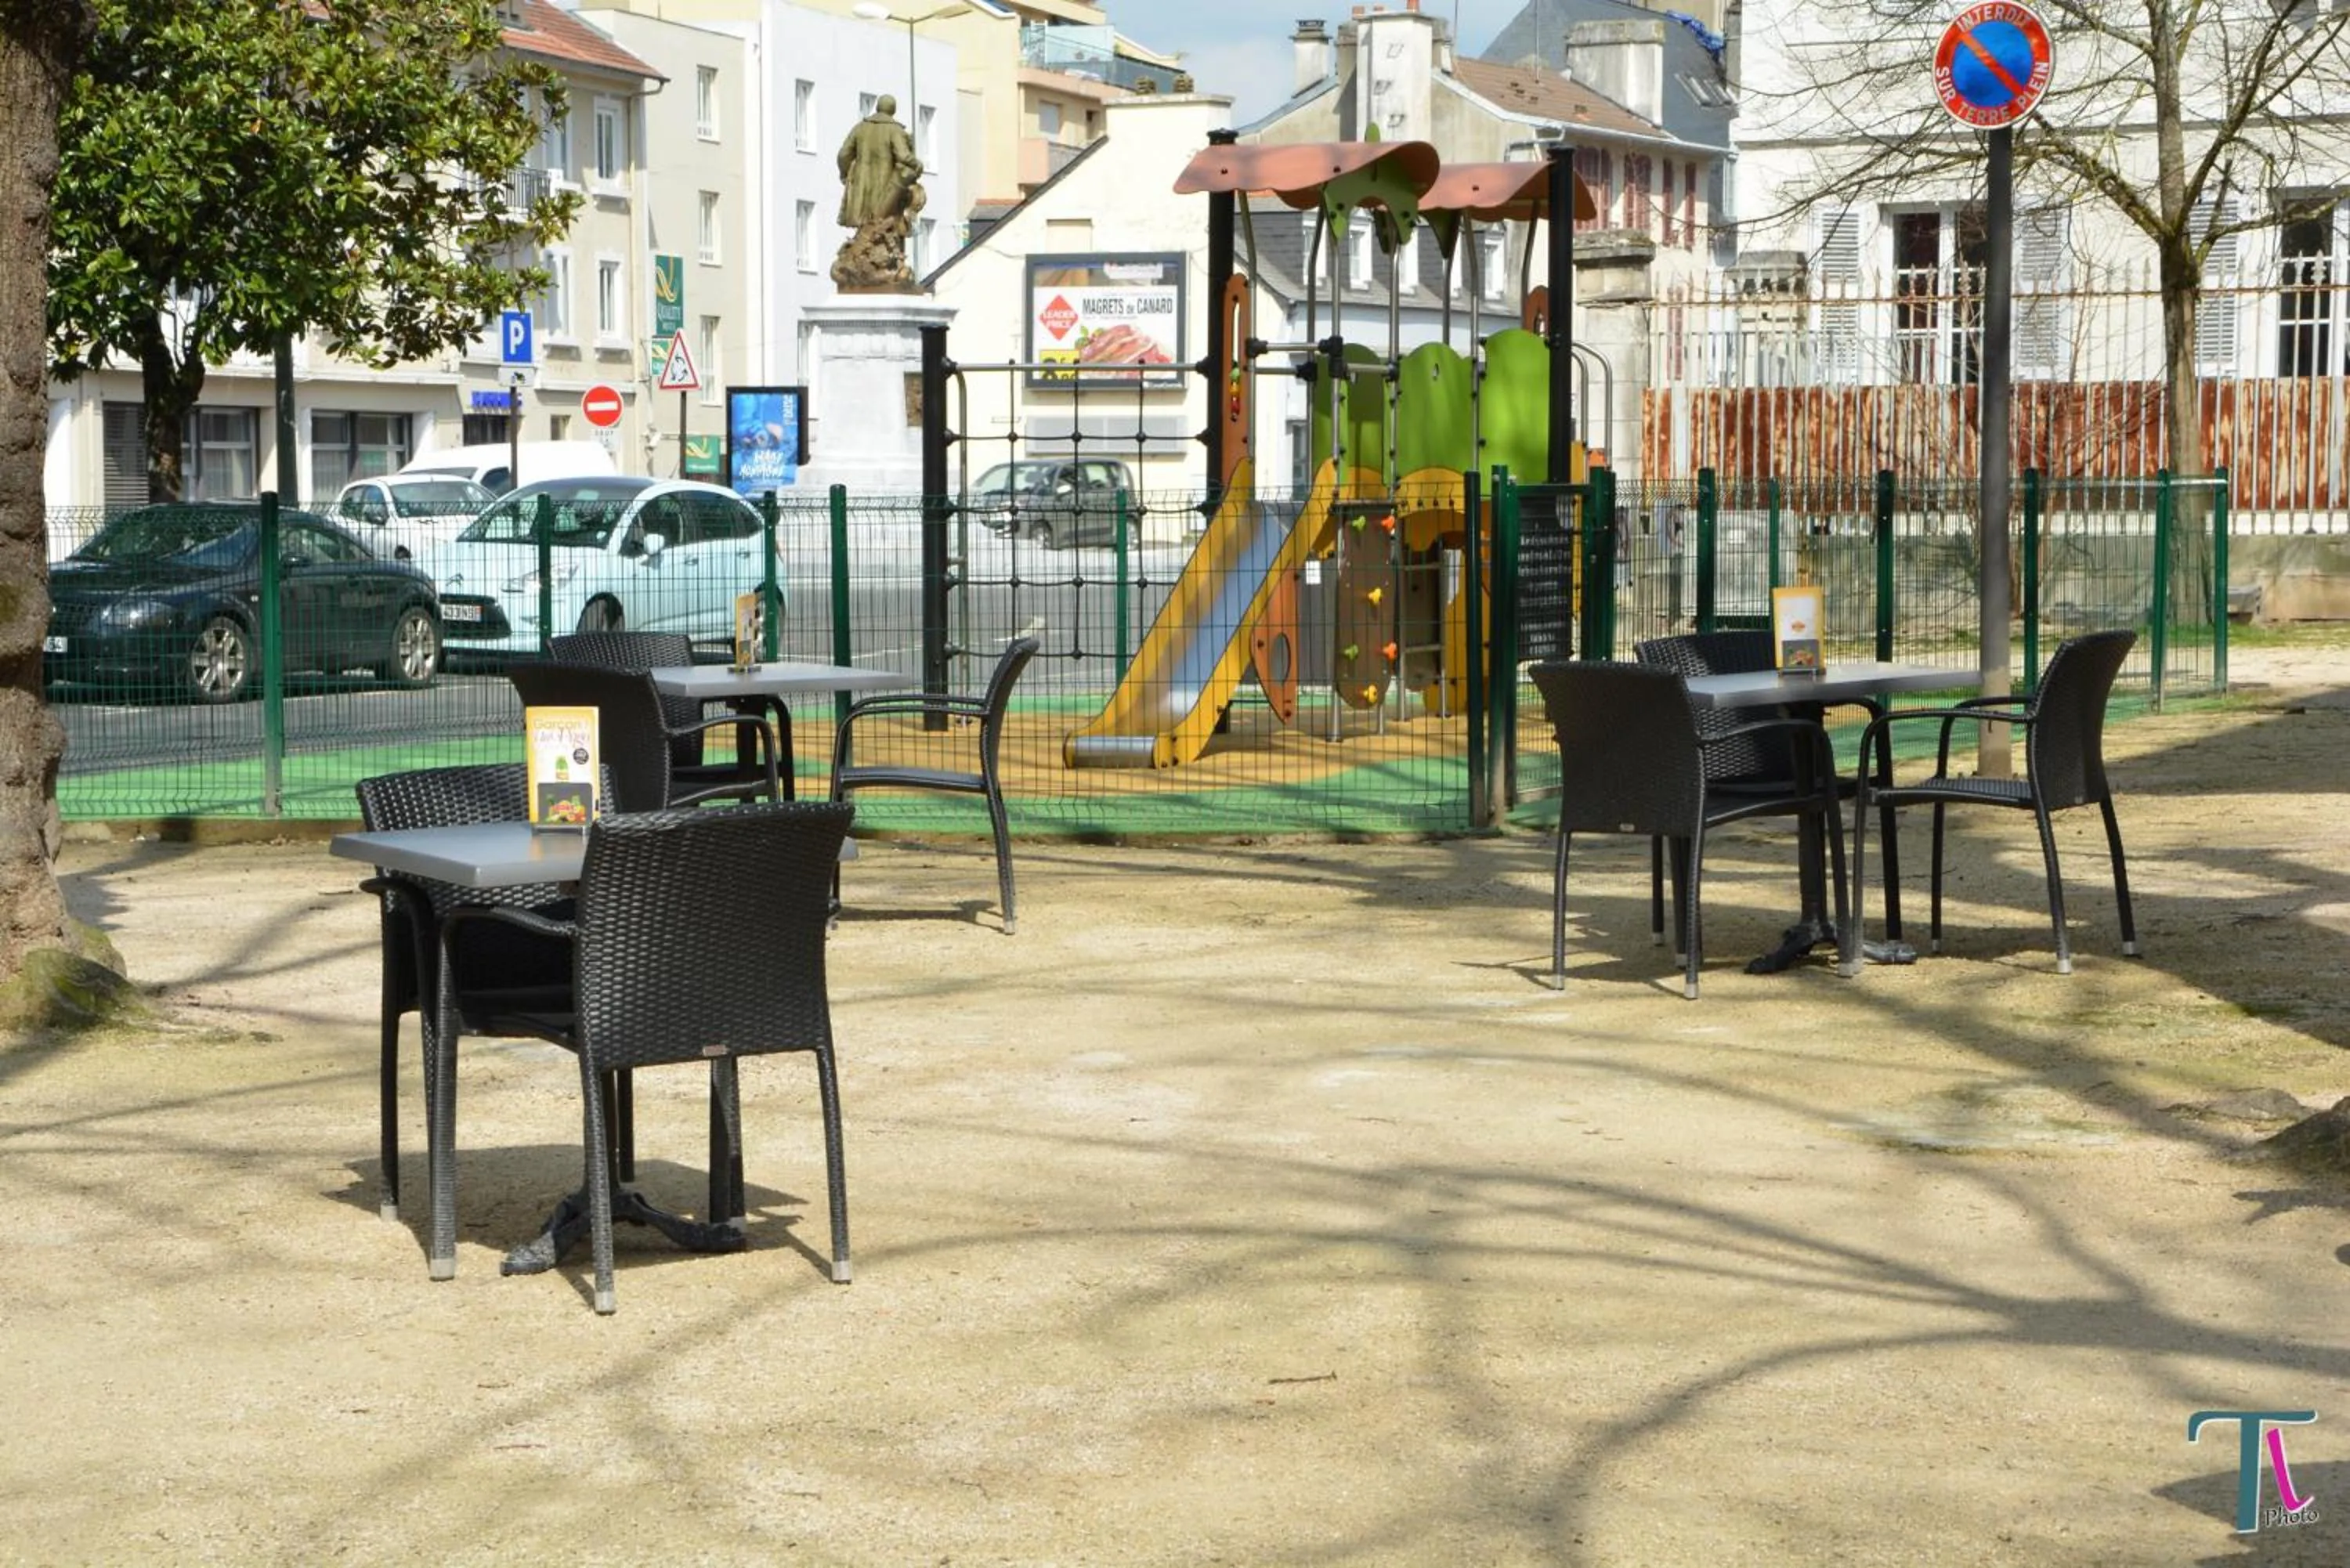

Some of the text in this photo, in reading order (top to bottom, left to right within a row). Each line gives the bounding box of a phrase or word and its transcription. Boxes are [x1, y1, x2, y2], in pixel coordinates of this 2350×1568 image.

[1936, 62, 2049, 125] SUR TERRE PLEIN
[1083, 298, 1124, 314] MAGRETS
[1137, 298, 1173, 314] CANARD
[510, 319, 525, 355] P
